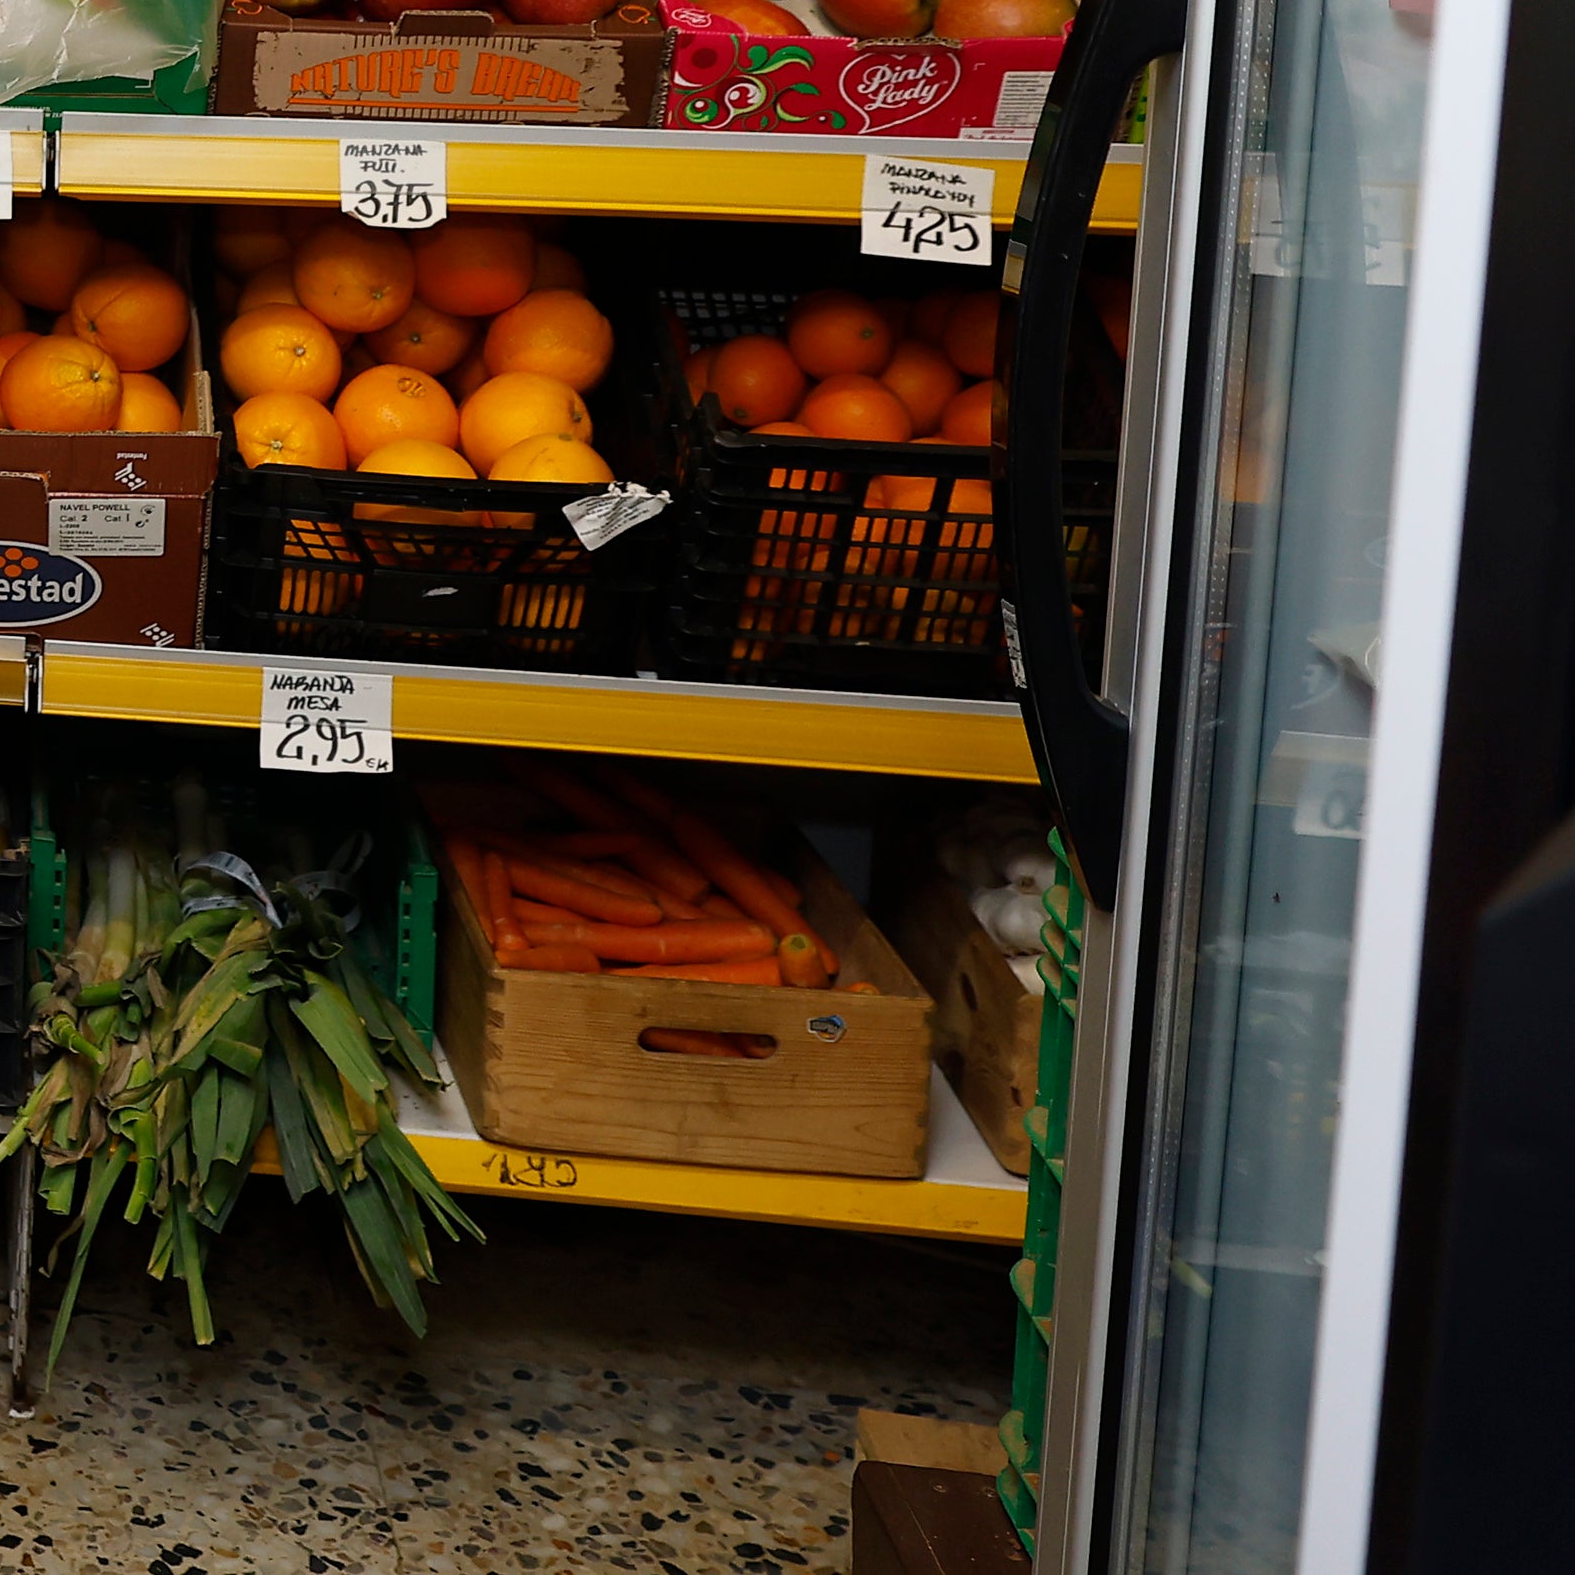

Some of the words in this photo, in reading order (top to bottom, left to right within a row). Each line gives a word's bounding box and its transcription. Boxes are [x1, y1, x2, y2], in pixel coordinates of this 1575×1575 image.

[290, 47, 461, 100] NATURE'S
[857, 56, 939, 95] Pink
[864, 80, 948, 112] Lady
[344, 143, 428, 158] MANZANA
[880, 162, 968, 187] MANZANA
[353, 178, 435, 225] 3,75
[59, 503, 91, 512] NAVEL
[92, 503, 131, 512] POWELL
[81, 514, 88, 522] 2
[104, 514, 122, 522] Cat
[269, 673, 355, 696] NARANJA
[287, 694, 343, 712] MESA
[277, 715, 365, 768] 2,95
